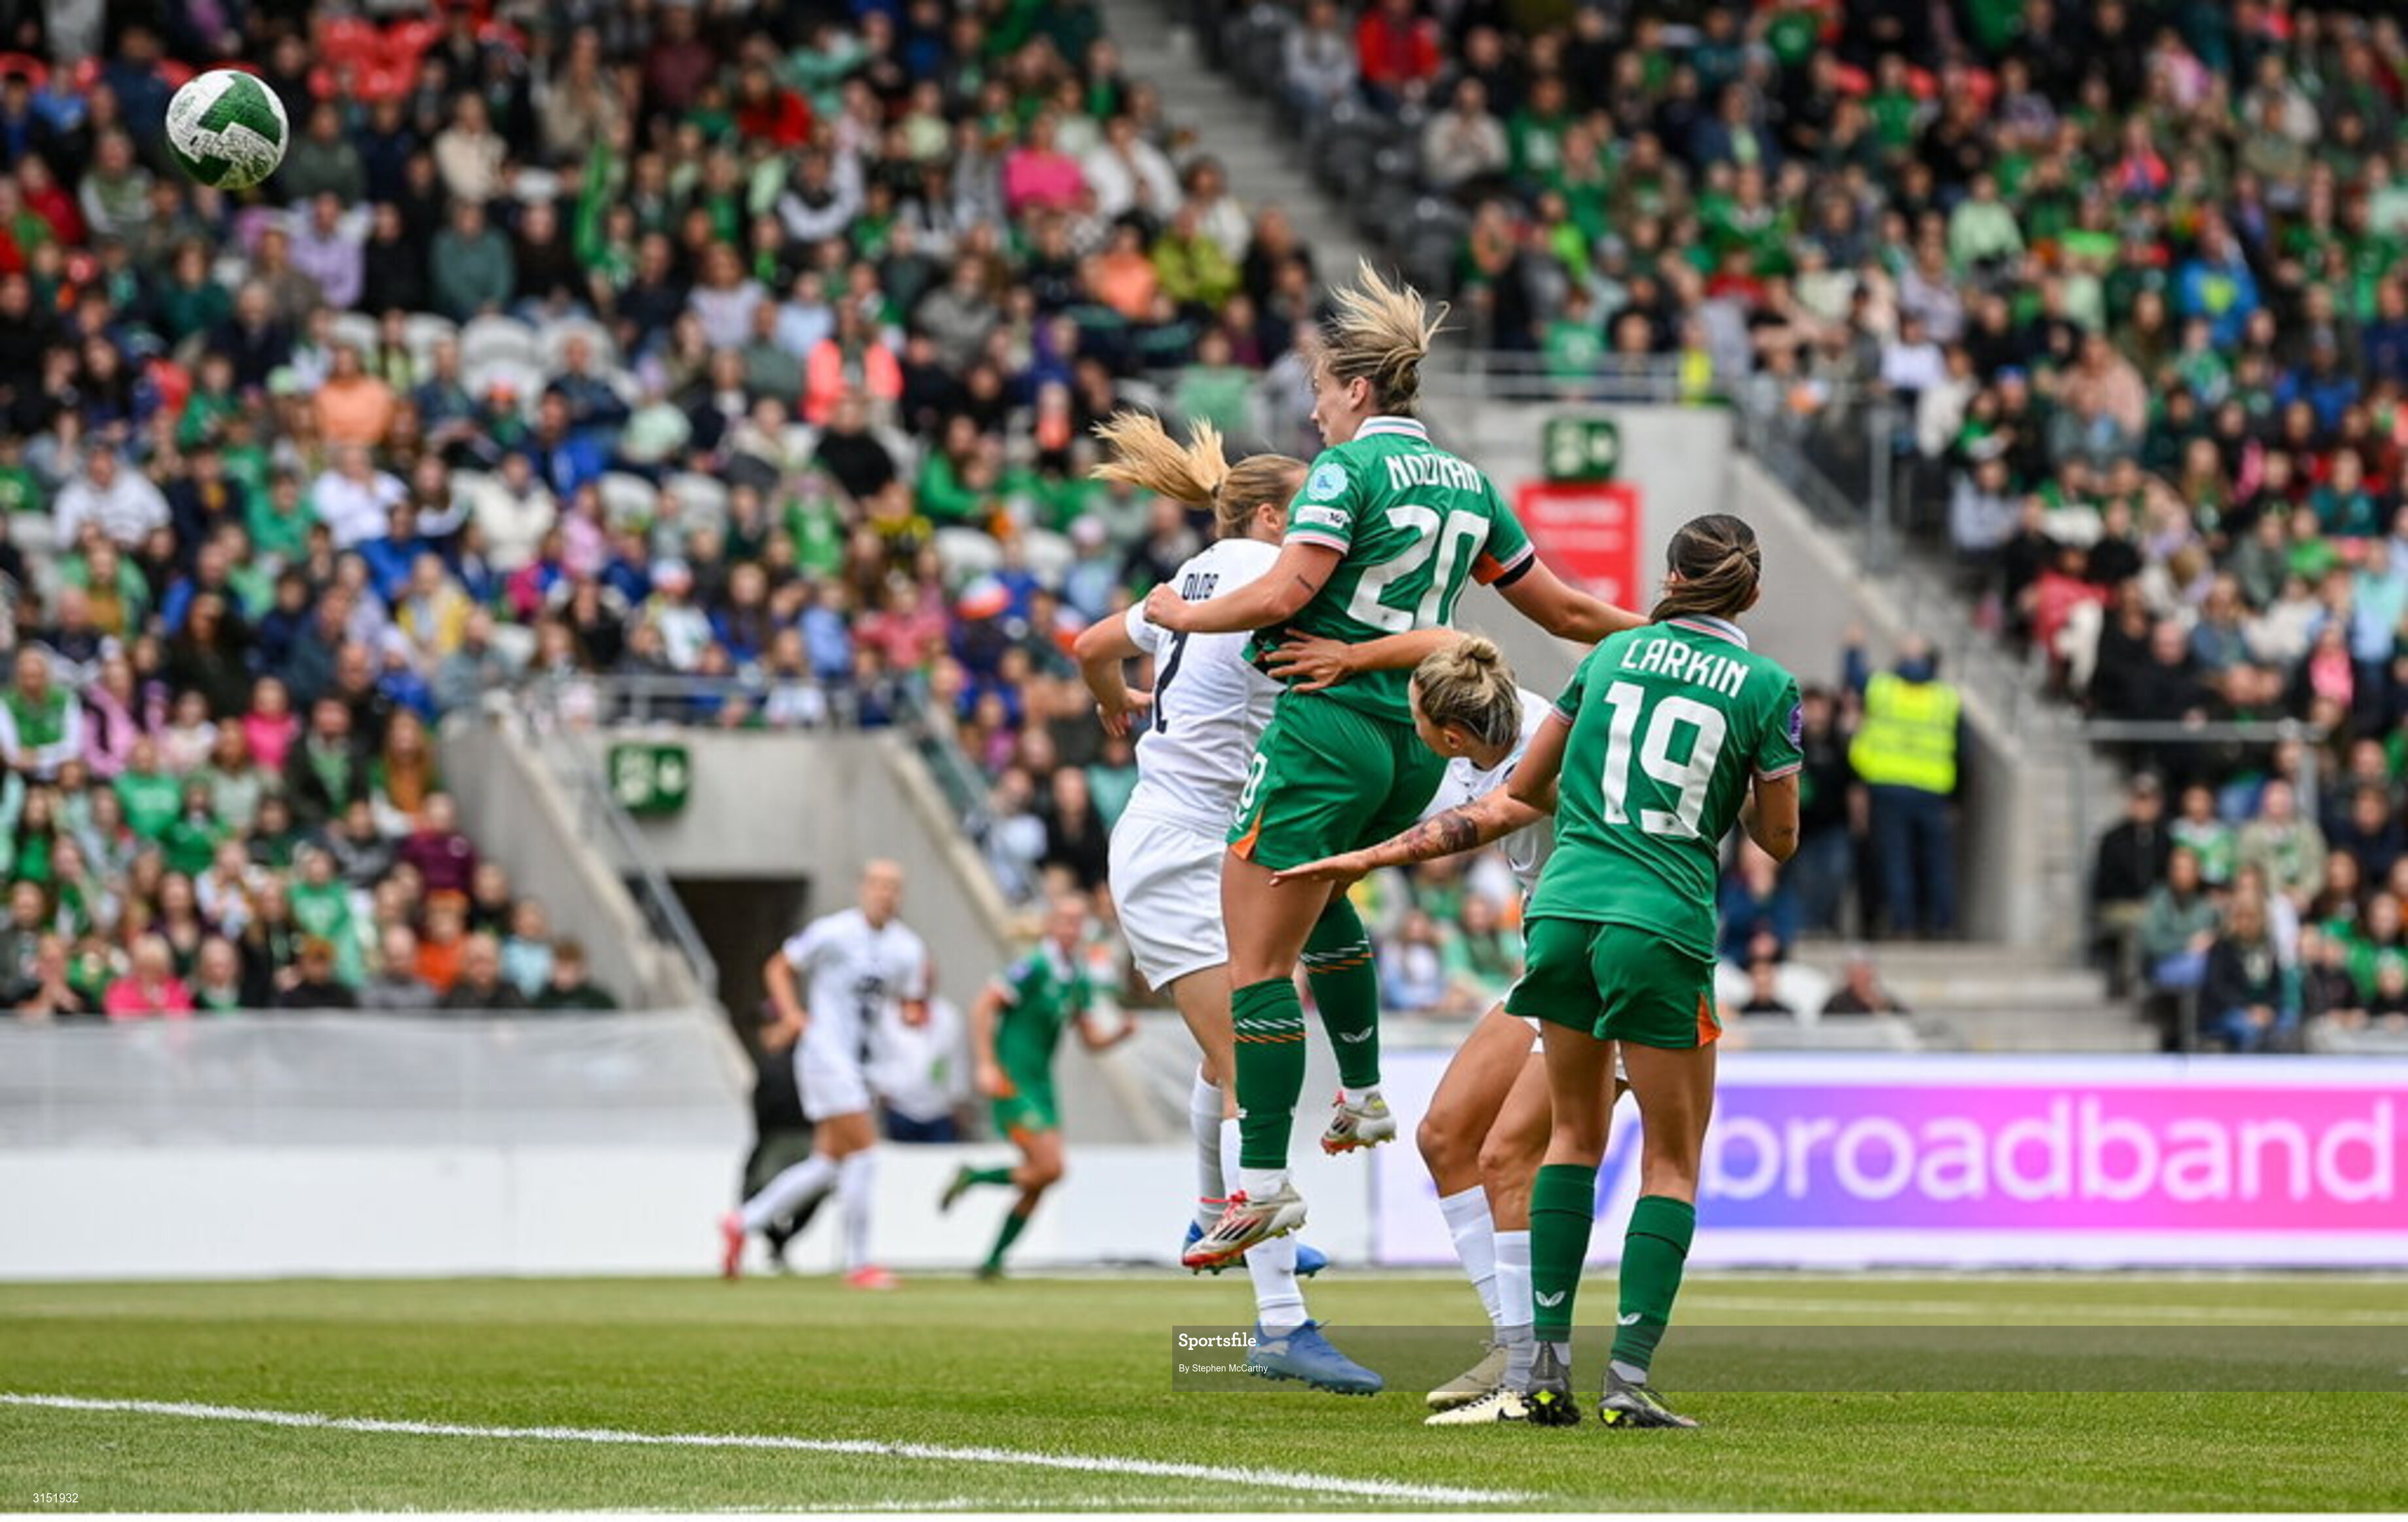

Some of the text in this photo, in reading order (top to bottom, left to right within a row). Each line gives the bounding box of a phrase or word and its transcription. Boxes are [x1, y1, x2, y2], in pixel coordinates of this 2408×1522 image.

[1347, 504, 1490, 632] 20
[1621, 639, 1750, 698] LARKIN
[1601, 681, 1727, 840] 19
[1702, 1095, 2394, 1202] broadband
